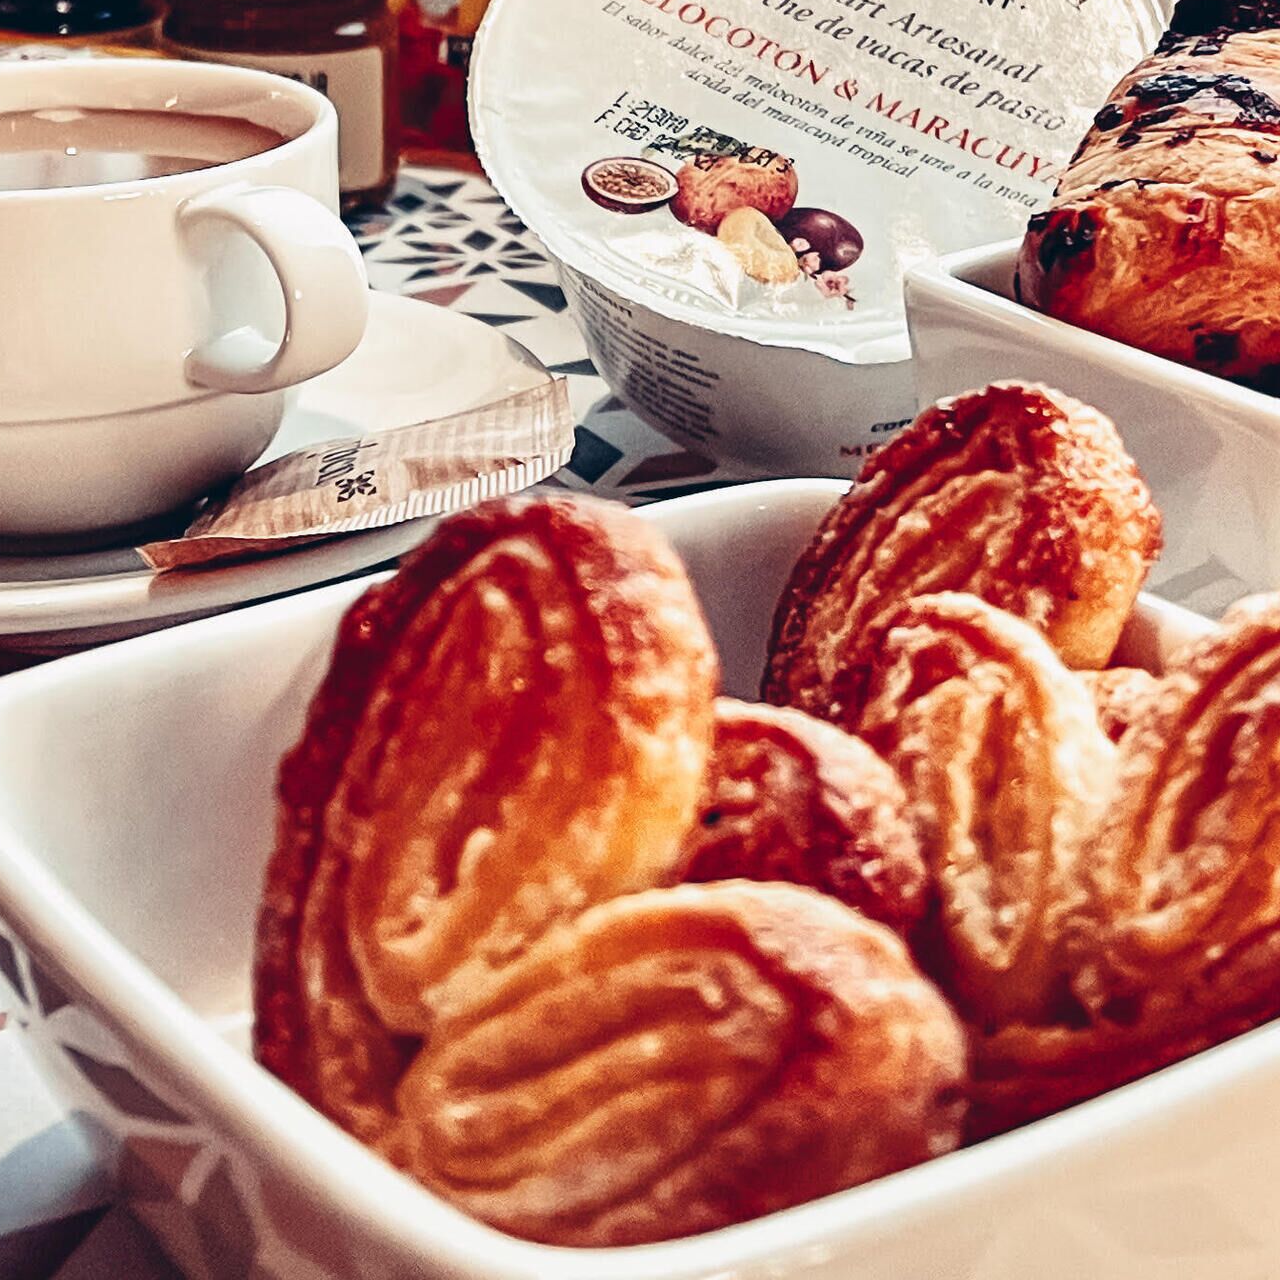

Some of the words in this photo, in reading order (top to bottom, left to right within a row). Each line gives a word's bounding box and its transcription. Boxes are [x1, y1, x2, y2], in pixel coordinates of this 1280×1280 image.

[814, 15, 854, 41] de
[856, 35, 939, 79] vacas
[939, 70, 982, 97] de
[975, 88, 1067, 132] pasto
[833, 78, 860, 102] &
[888, 12, 1044, 84] Artesanal
[602, 0, 627, 17] El
[622, 12, 670, 40] sabor
[668, 36, 715, 64] dulce
[713, 58, 746, 79] del
[743, 74, 830, 120] melocotón
[830, 112, 855, 130] de
[855, 125, 898, 149] viña
[896, 144, 919, 158] se
[919, 153, 956, 174] une
[955, 169, 972, 181] a
[972, 173, 993, 191] la
[994, 184, 1040, 209] nota
[731, 90, 764, 111] del
[763, 105, 847, 149] maracuyá
[847, 143, 921, 180] tropical
